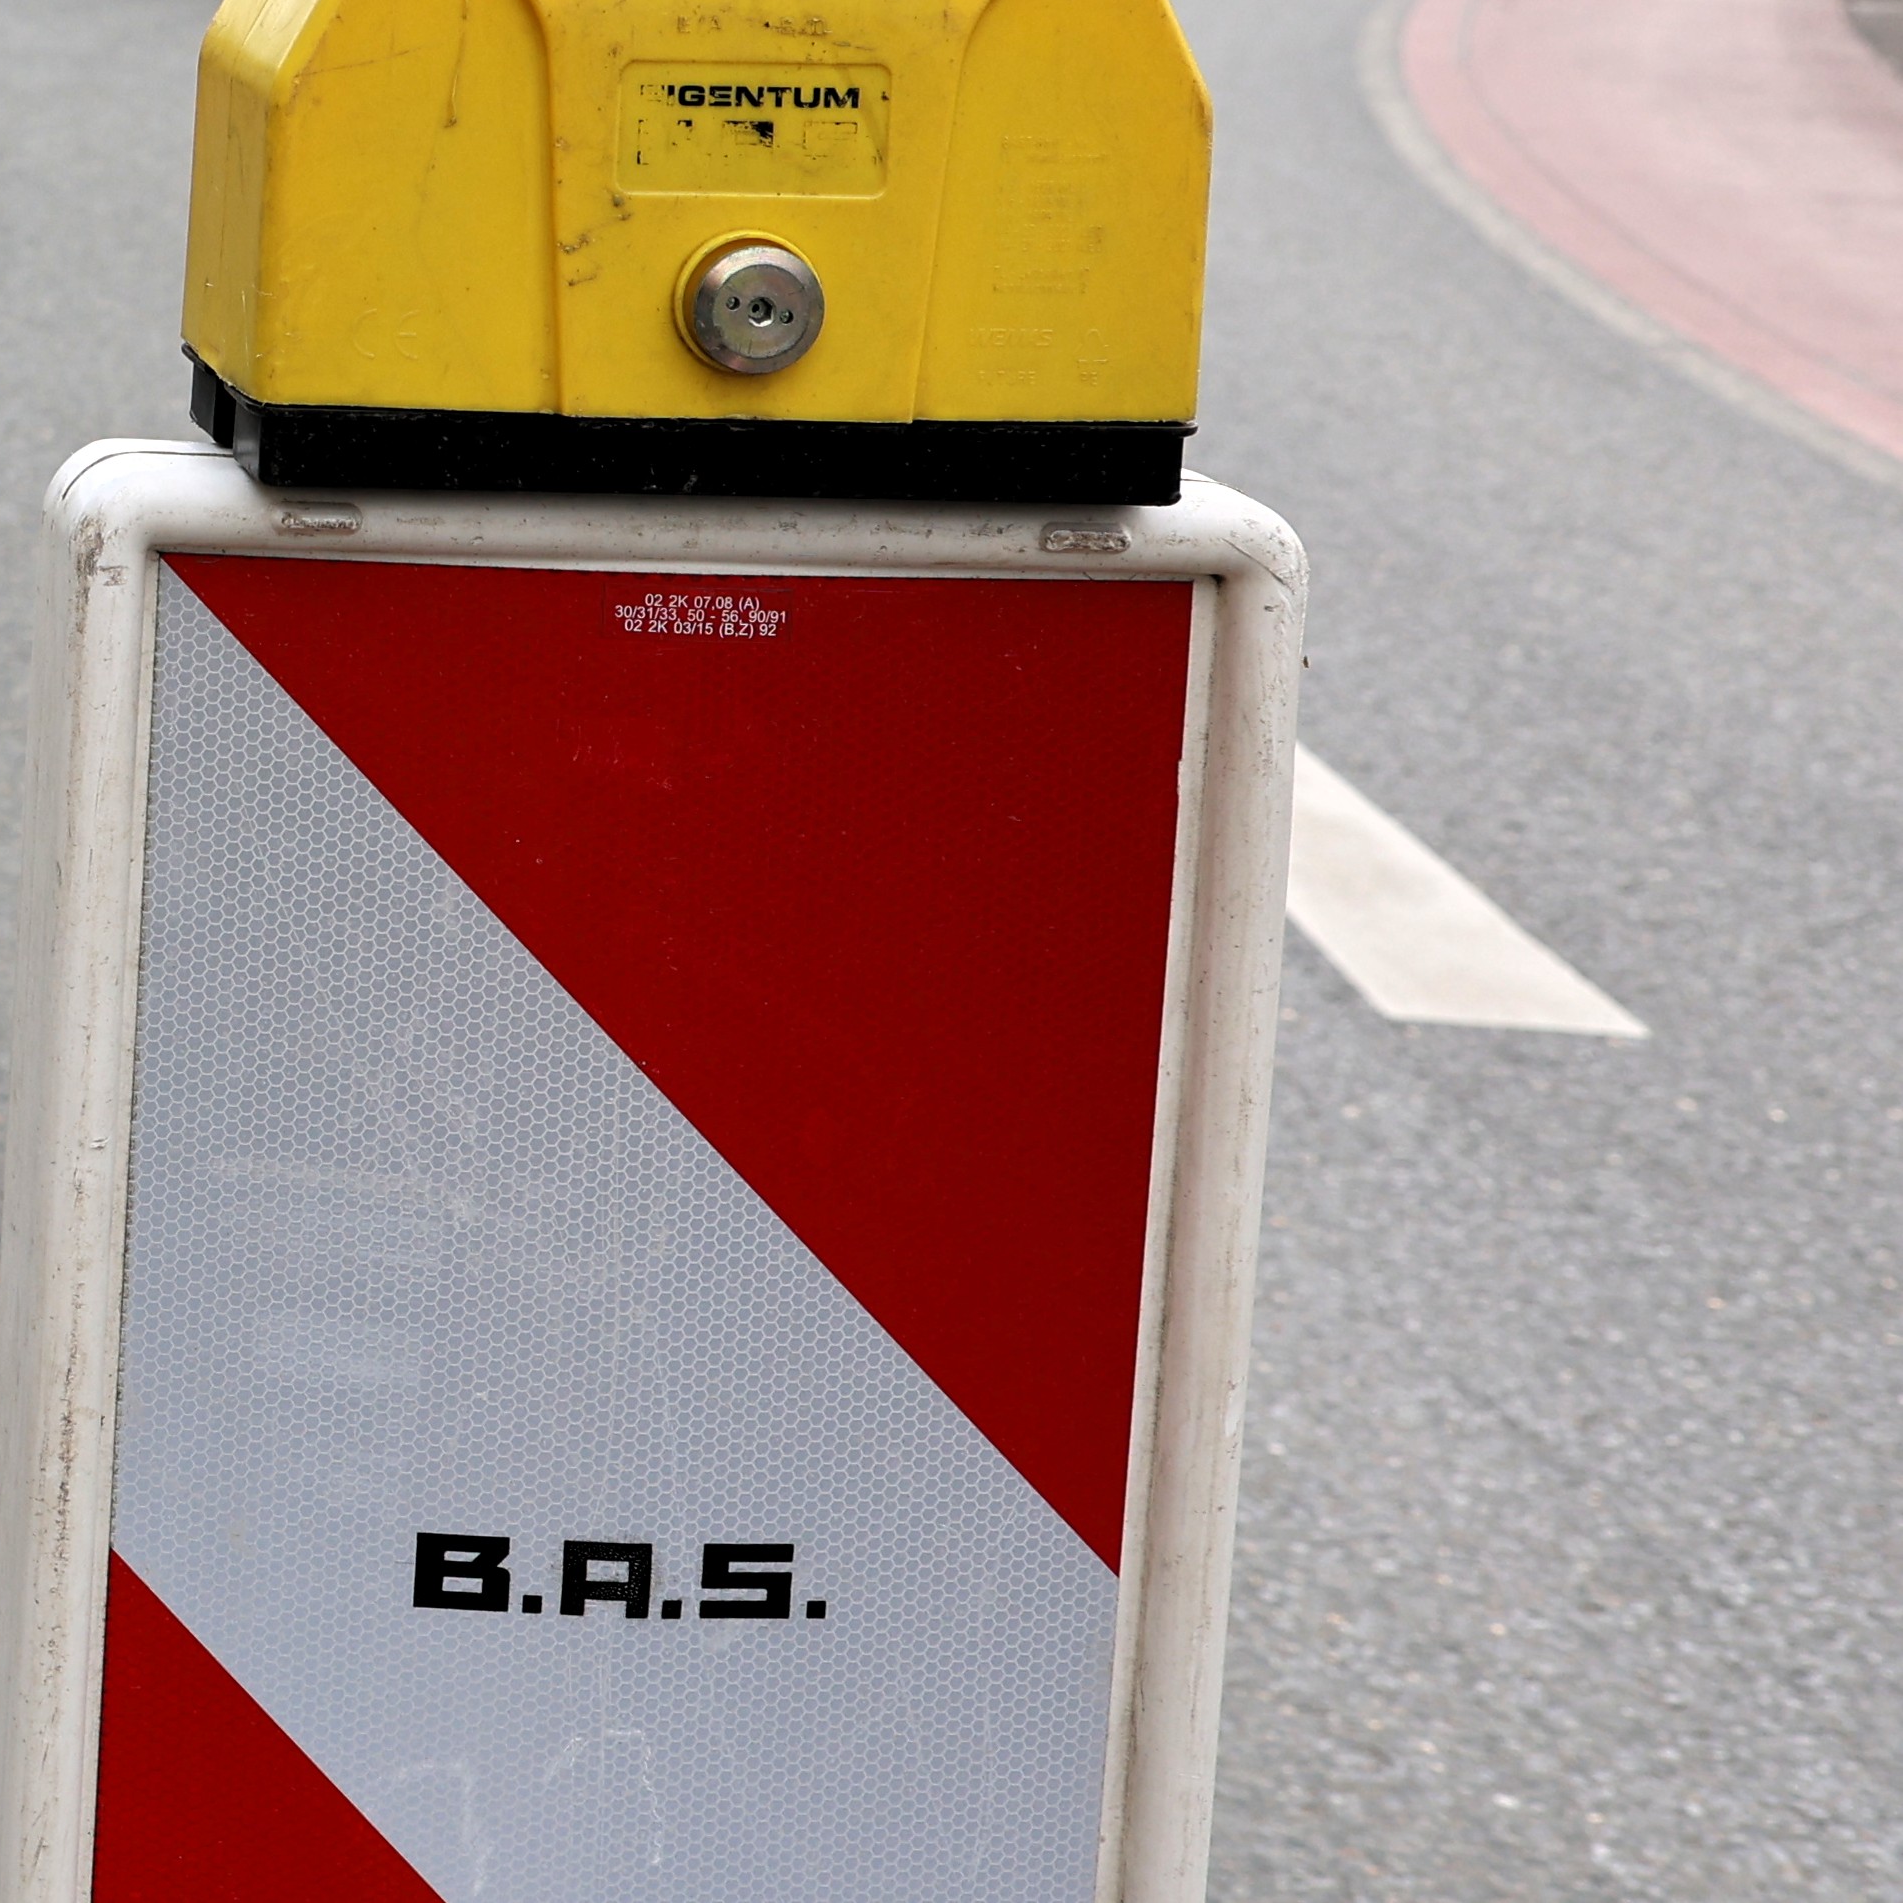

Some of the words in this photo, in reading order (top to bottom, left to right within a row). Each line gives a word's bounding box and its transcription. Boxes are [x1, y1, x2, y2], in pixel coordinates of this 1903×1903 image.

[640, 84, 860, 108] IGENTUM
[645, 594, 663, 608] 02
[668, 595, 689, 609] 2K
[738, 596, 760, 611] (A)
[687, 609, 705, 621] 50
[749, 610, 786, 624] 90/91
[624, 619, 642, 633] 02
[648, 620, 668, 634] 2K
[674, 622, 714, 635] 03/15
[759, 624, 777, 637] 92
[413, 1532, 826, 1619] B.A.S.
